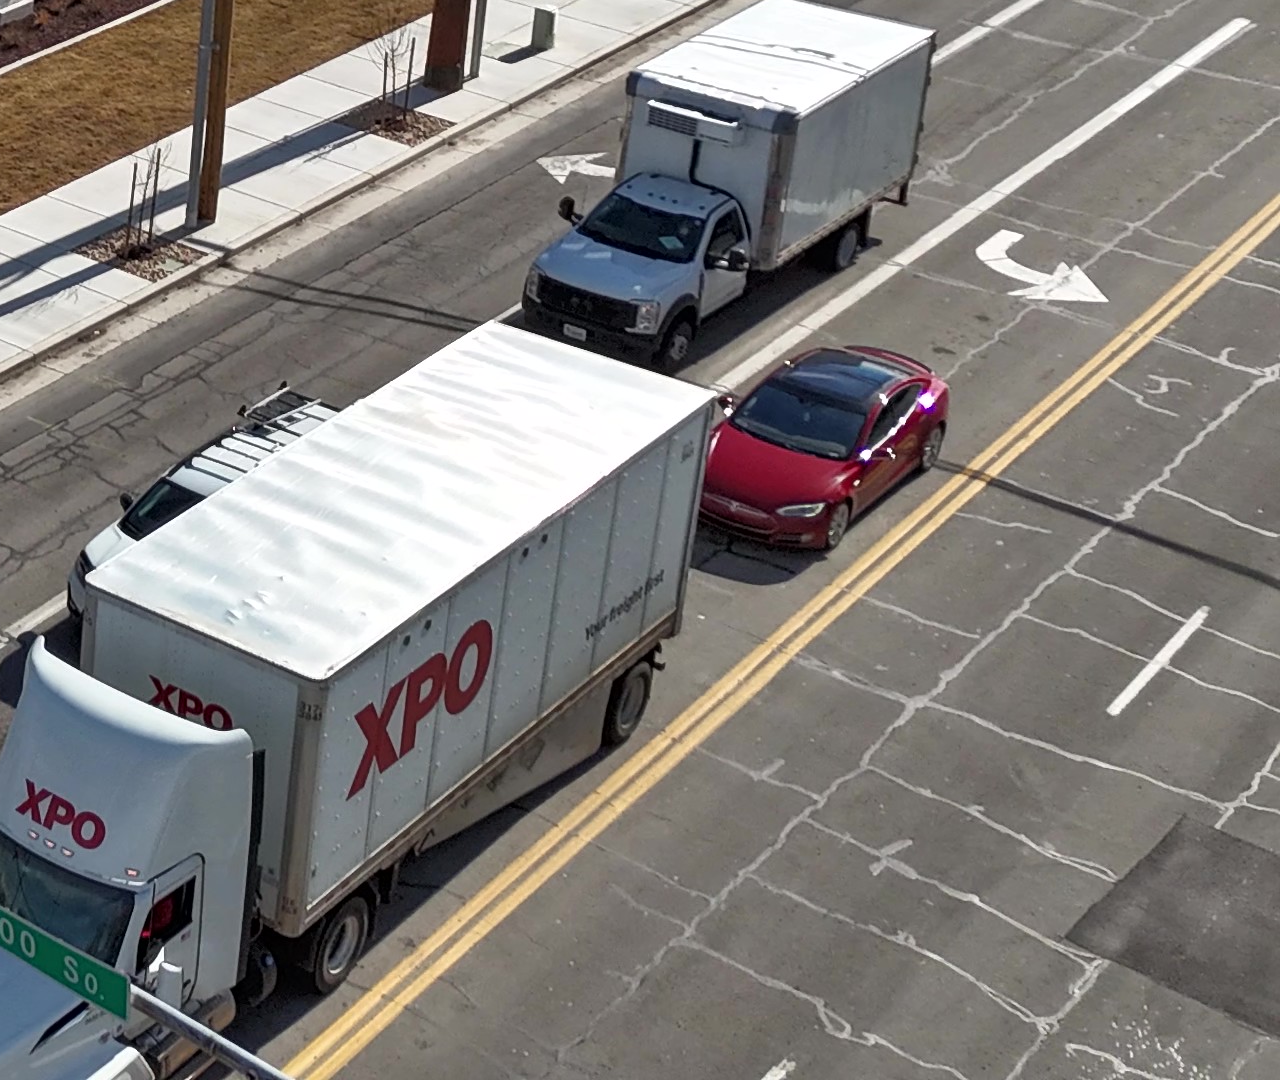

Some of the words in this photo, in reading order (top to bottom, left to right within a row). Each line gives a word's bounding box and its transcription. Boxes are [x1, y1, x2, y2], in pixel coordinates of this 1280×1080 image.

[148, 674, 234, 732] XPO
[345, 619, 493, 802] XPO
[15, 778, 106, 850] XPO
